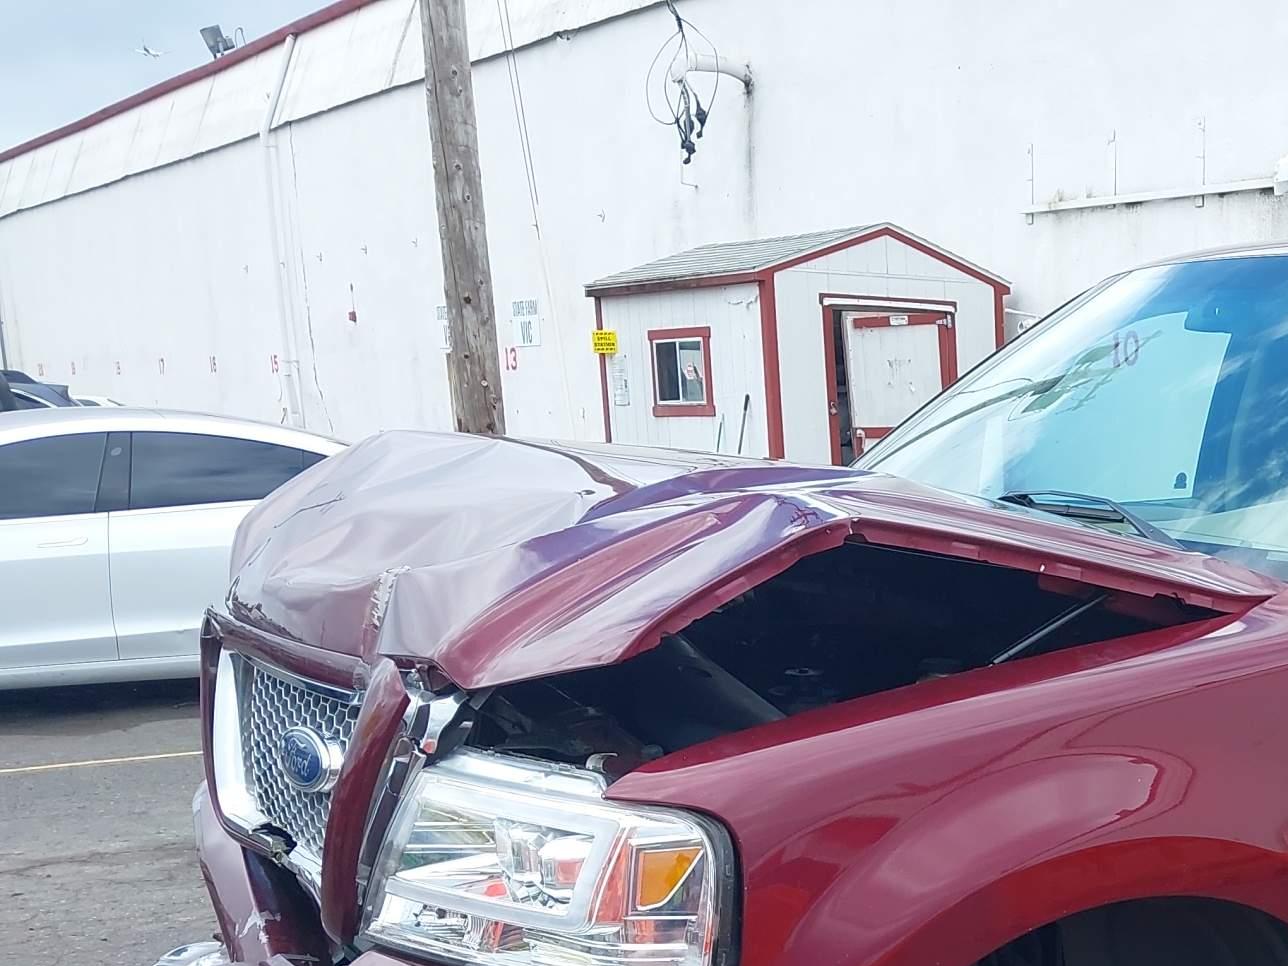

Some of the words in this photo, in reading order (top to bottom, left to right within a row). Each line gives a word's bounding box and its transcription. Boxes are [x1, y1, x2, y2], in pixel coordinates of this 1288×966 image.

[520, 320, 533, 344] VIC
[504, 346, 518, 371] 13
[1112, 330, 1140, 369] 10
[270, 354, 279, 374] 15
[285, 736, 313, 777] Ford
